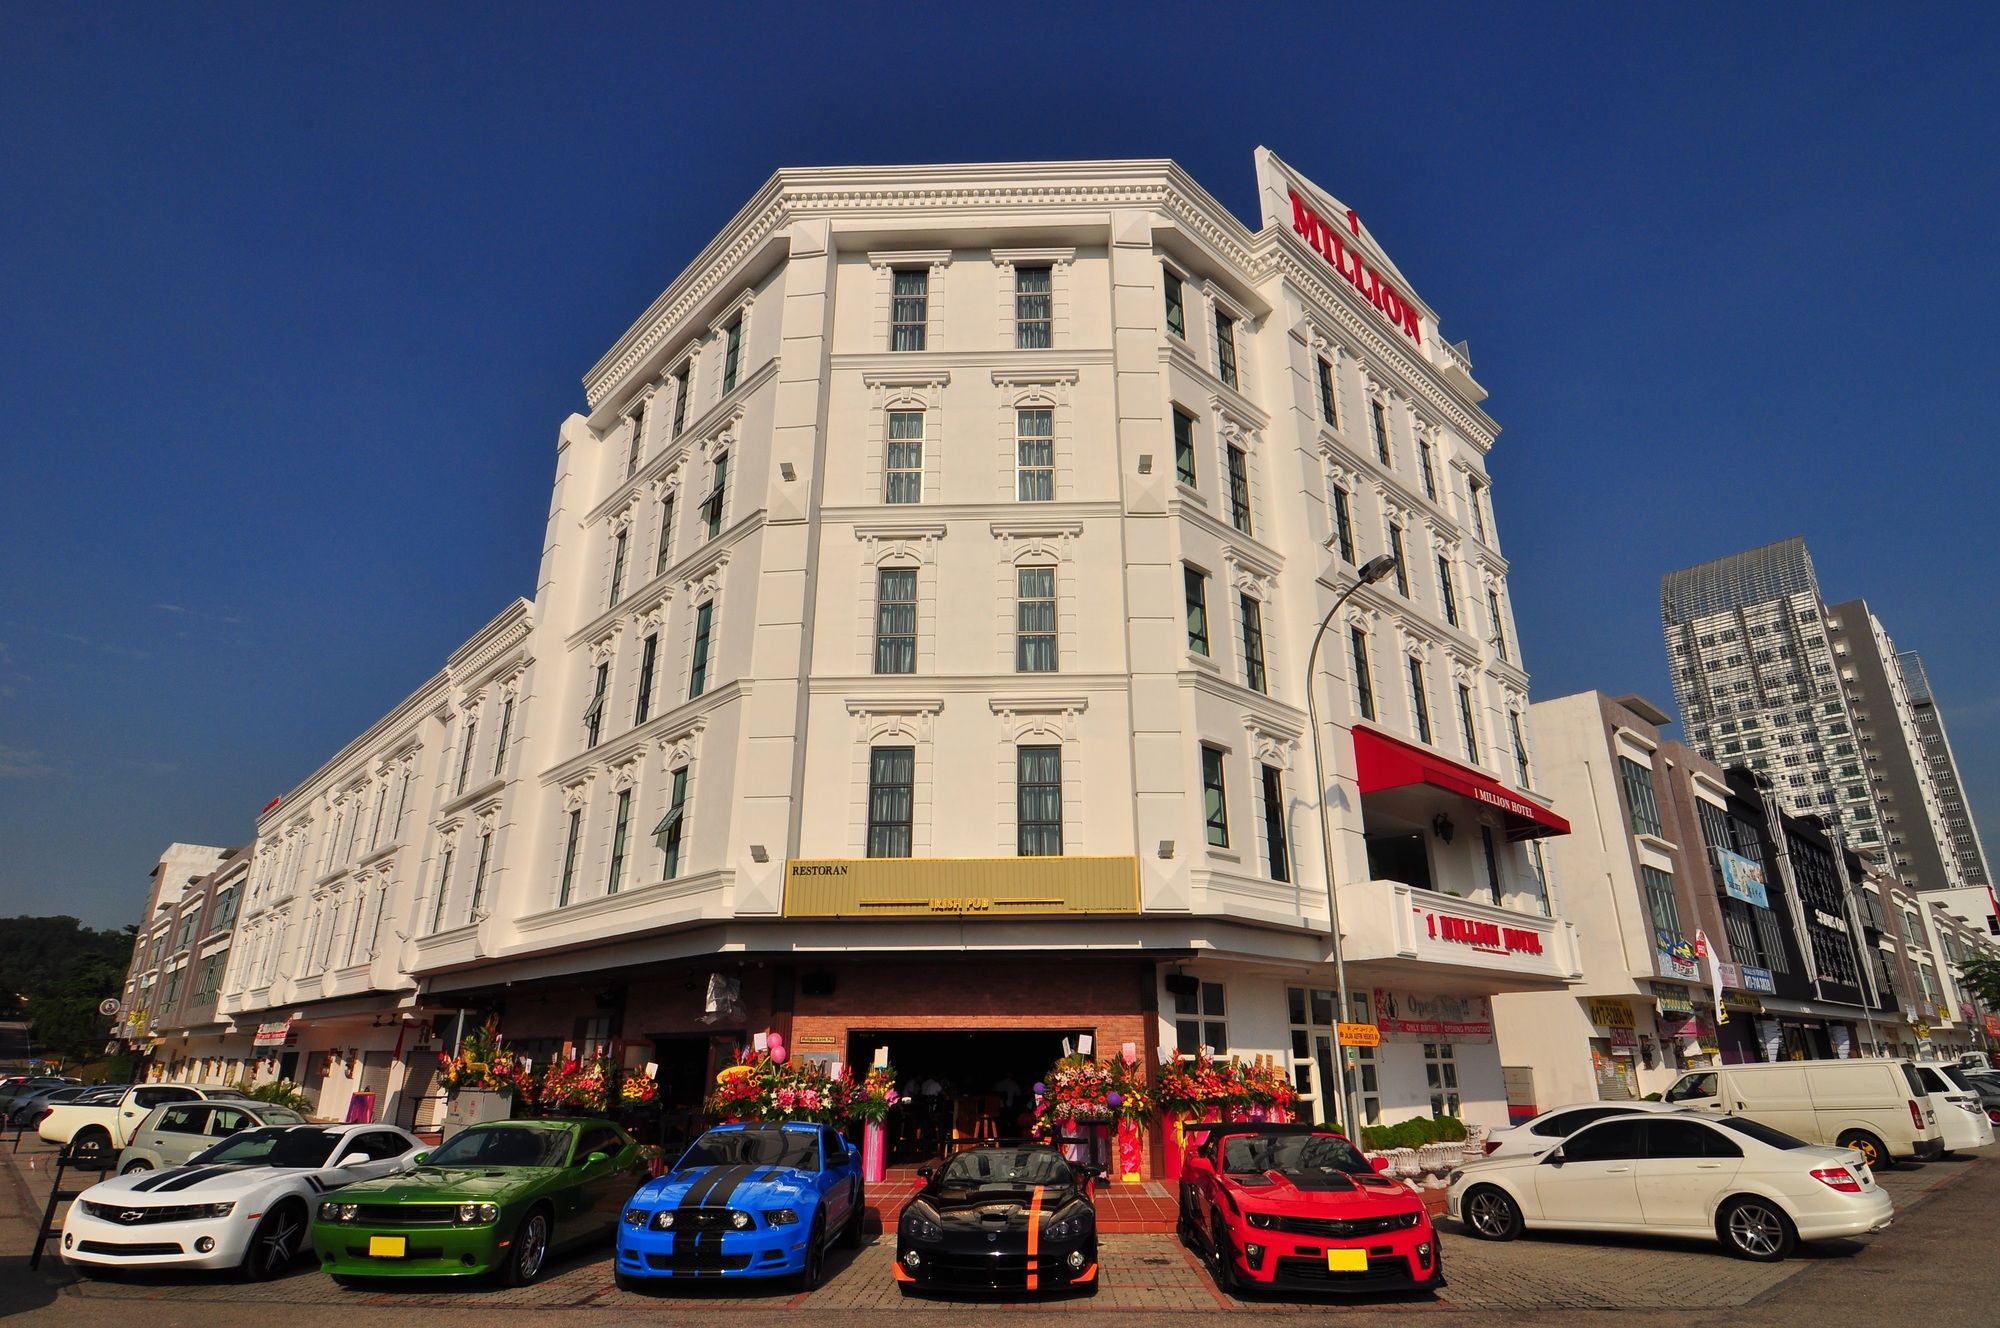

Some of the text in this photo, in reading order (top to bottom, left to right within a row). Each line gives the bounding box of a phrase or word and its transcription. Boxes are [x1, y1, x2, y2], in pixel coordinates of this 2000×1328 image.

[1288, 190, 1421, 345] MILLION
[1479, 790, 1511, 810] MILLION
[1511, 801, 1535, 819] HOTEL
[792, 865, 848, 876] RESTORAN
[929, 897, 989, 912] IRISH PUB
[1426, 913, 1437, 940] 1
